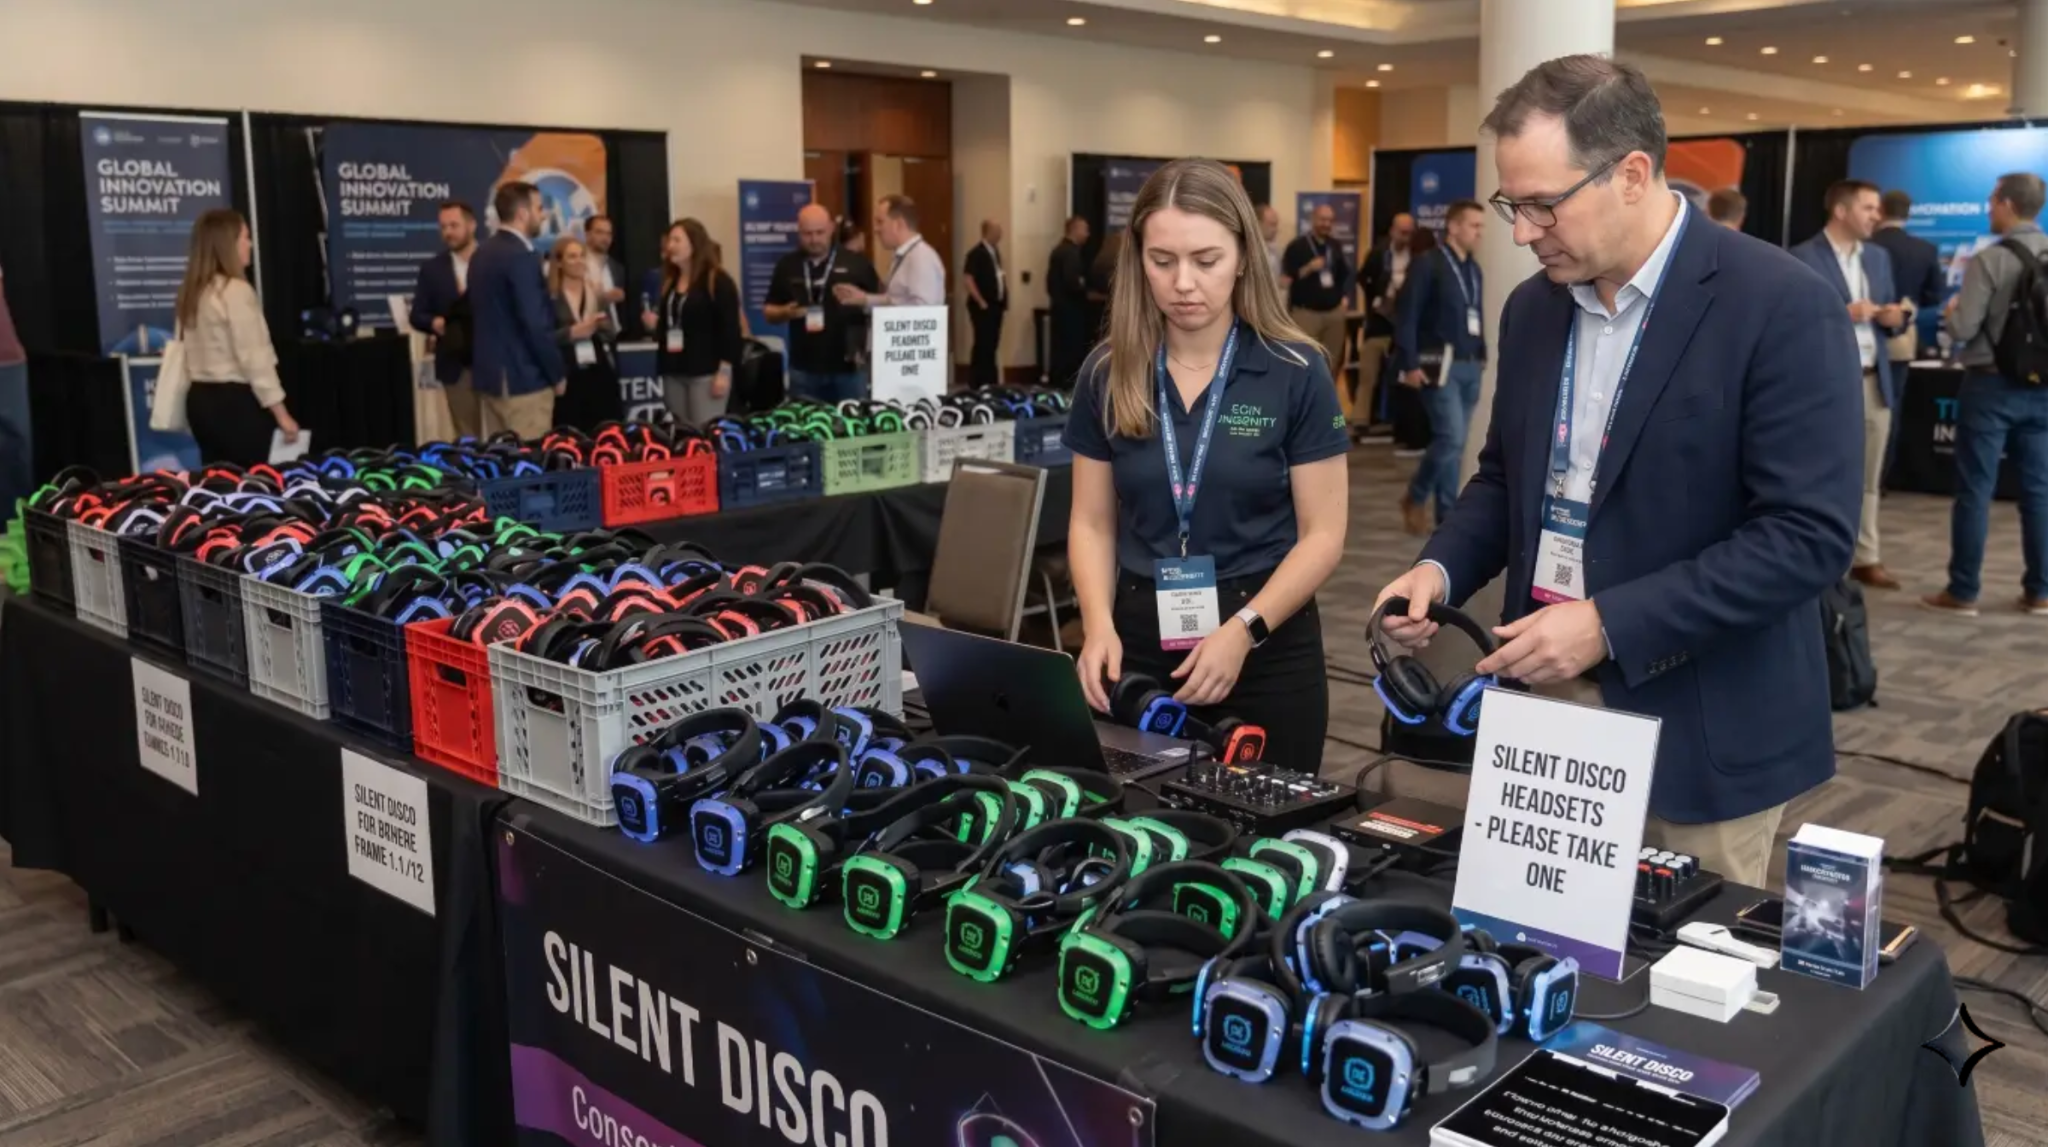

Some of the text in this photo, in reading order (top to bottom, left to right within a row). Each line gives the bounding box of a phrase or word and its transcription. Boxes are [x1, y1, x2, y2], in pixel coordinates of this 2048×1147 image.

[98, 158, 178, 177] GLOBAL
[338, 162, 411, 180] GLOBAL
[99, 178, 221, 197] INNOVATION
[340, 182, 449, 199] INNOVATION
[101, 196, 180, 214] SUMMIT
[340, 200, 412, 216] SUMMIT
[1492, 744, 1626, 793] SILENT DISCO
[355, 783, 416, 827] SILENT DISCO
[1500, 782, 1605, 827] HEADSETS
[358, 811, 376, 835] FOR
[354, 834, 387, 866] FRAME
[1487, 815, 1561, 855] PLEASE
[1567, 833, 1619, 869] TAKE
[1526, 861, 1567, 894] ONE
[544, 931, 889, 1147] SILENT DISCO
[1590, 1044, 1647, 1067] SILENT
[1642, 1060, 1694, 1081] DISCO
[572, 1085, 676, 1147] Cons
